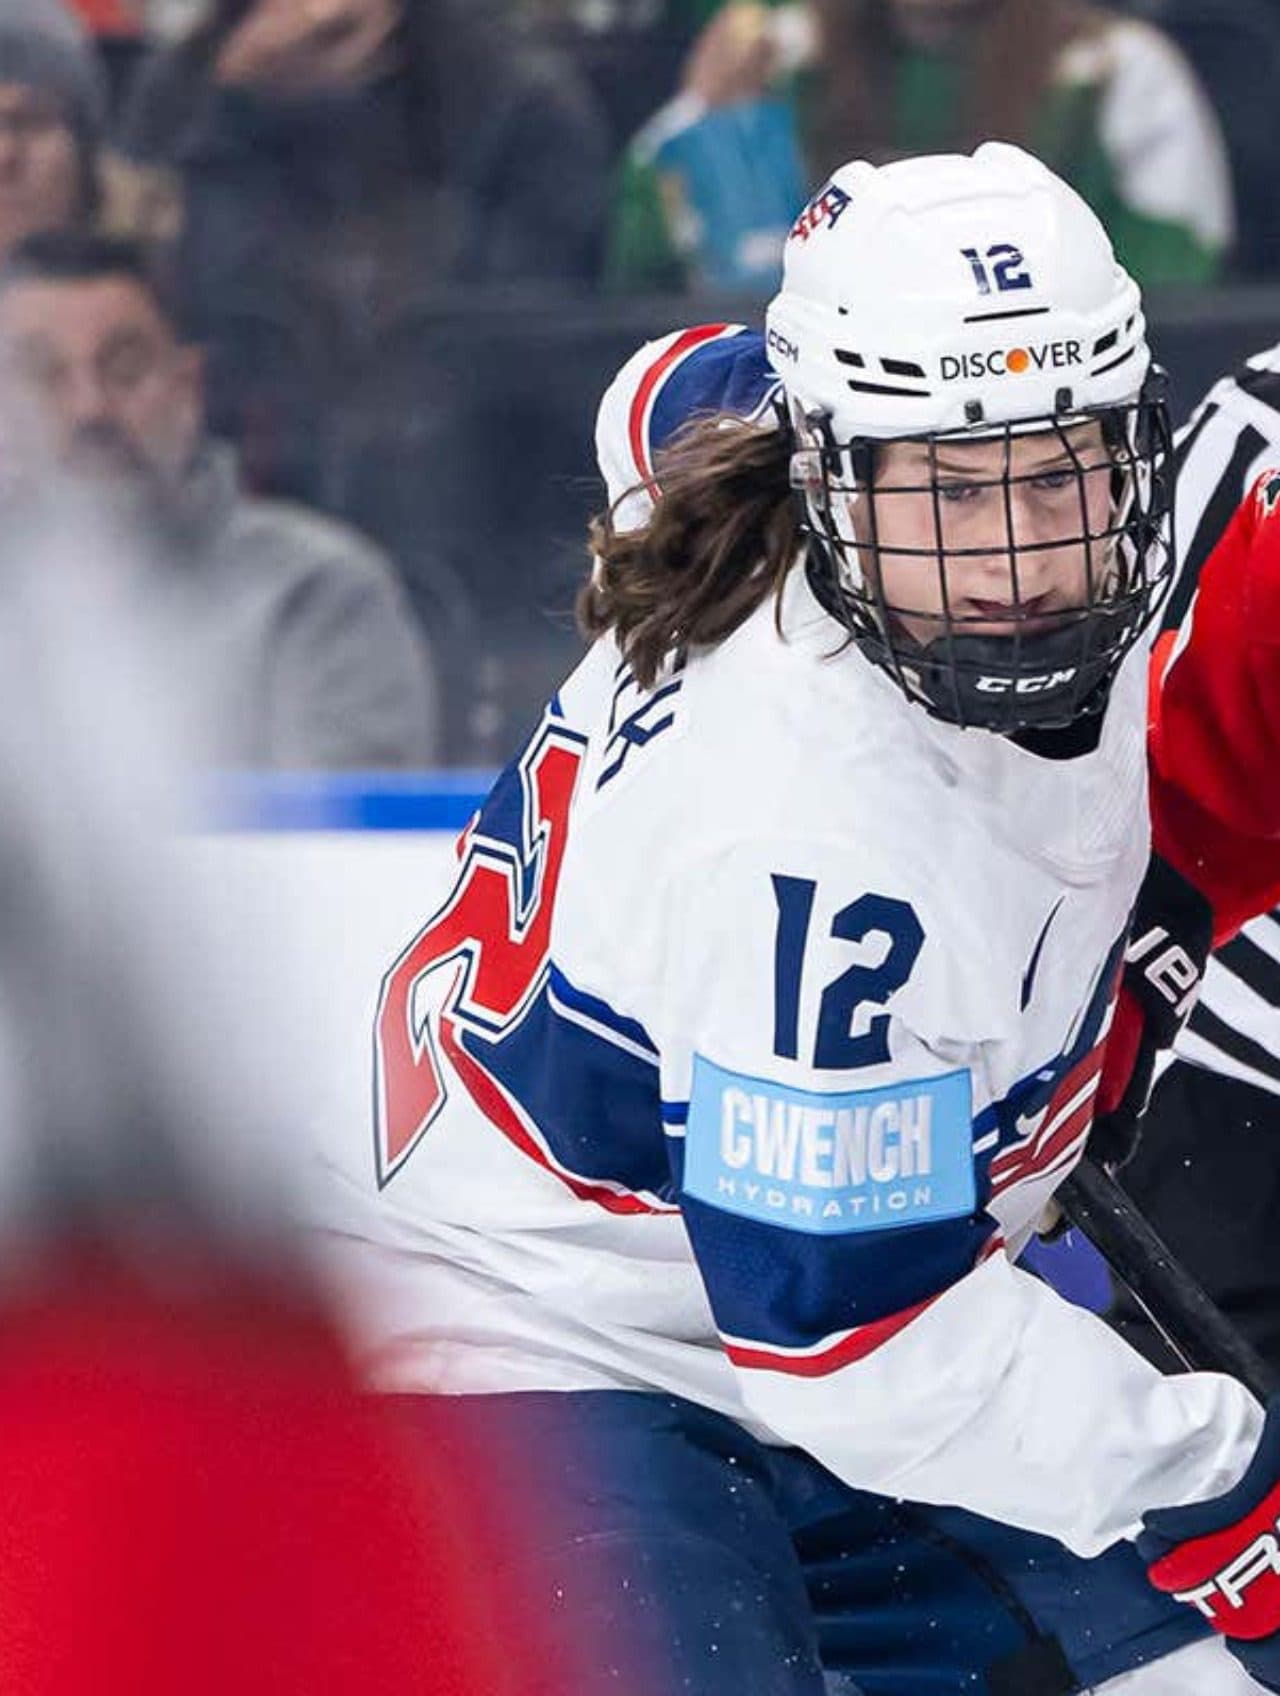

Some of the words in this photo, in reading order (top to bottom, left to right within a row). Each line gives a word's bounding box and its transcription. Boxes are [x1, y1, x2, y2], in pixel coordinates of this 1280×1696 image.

[960, 244, 1032, 295] 12
[767, 328, 799, 364] CCM
[940, 340, 1083, 382] DISCOVER
[975, 667, 1077, 694] CCM
[770, 873, 926, 1070] 12
[719, 1084, 934, 1188] CWENCH
[717, 1176, 933, 1217] HYDRATION
